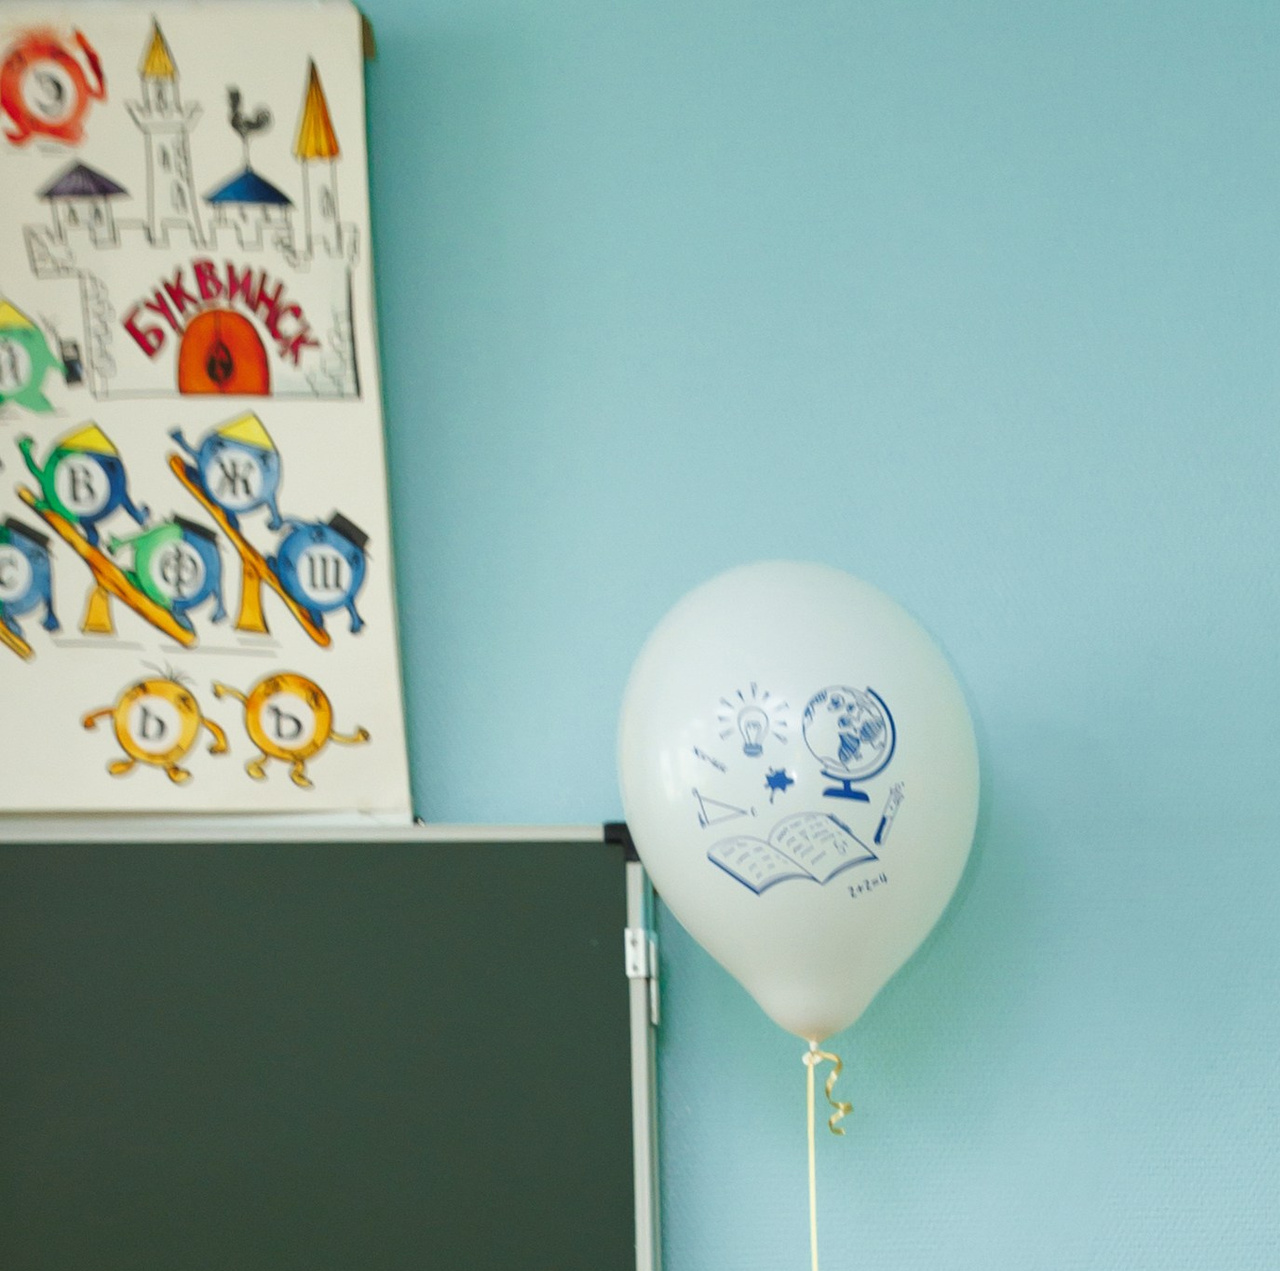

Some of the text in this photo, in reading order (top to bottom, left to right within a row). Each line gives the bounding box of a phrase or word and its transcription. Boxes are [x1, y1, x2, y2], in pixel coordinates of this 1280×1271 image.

[121, 258, 321, 367] БУКВИНСК
[213, 458, 257, 499] Ж
[159, 544, 201, 599] Ф
[306, 551, 344, 592] Ш
[847, 872, 888, 899] 2+2=4
